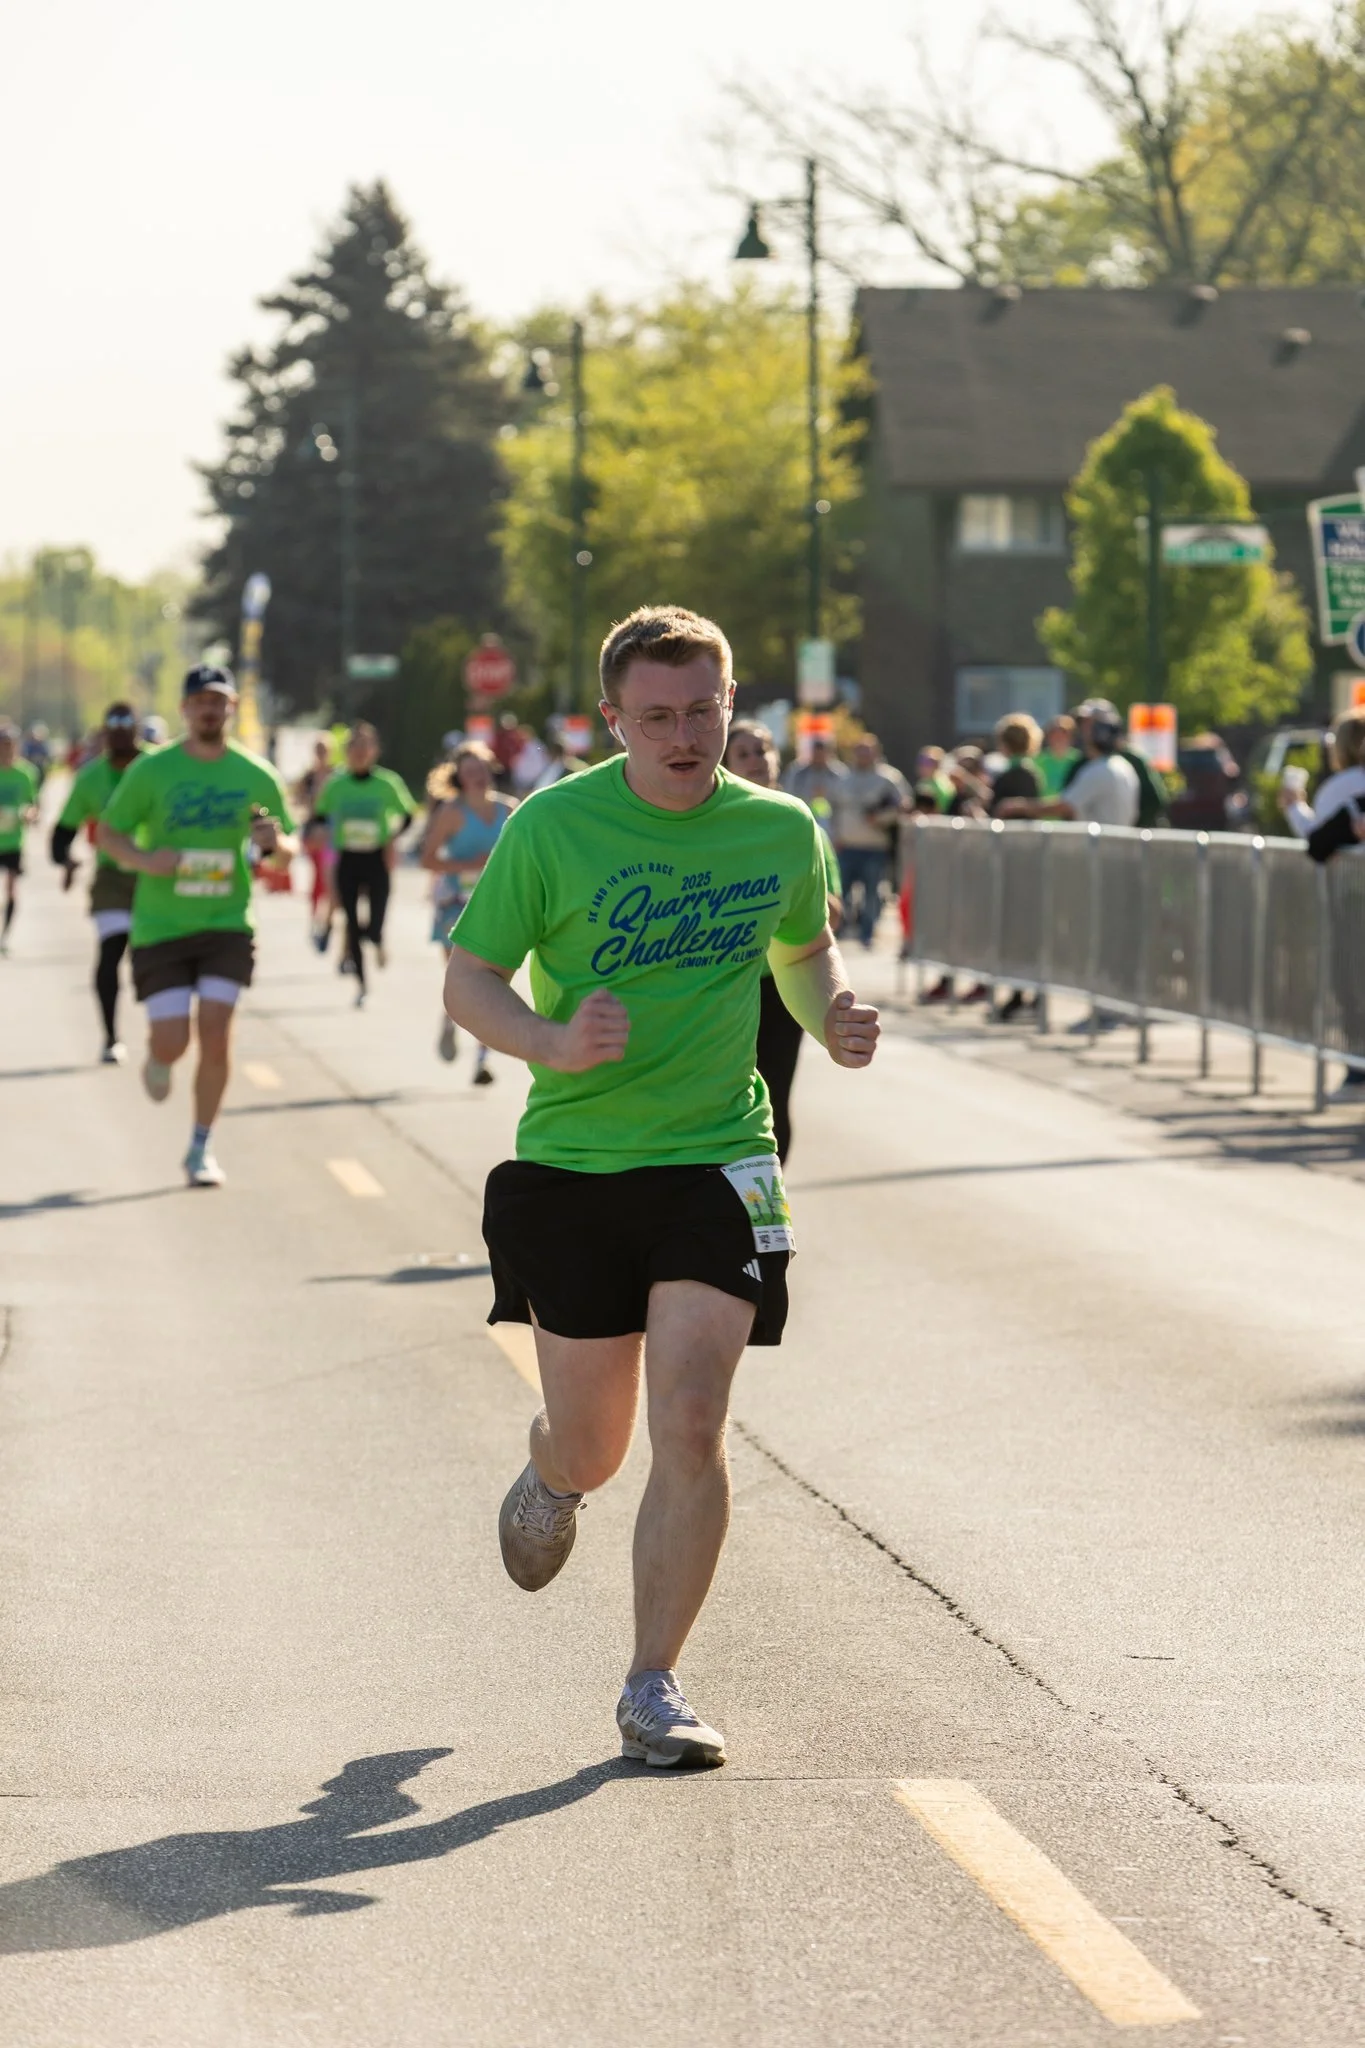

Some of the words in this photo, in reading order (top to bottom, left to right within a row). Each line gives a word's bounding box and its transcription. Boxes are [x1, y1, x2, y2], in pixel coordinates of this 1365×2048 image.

[620, 863, 644, 880] MILE
[648, 862, 675, 877] RACE
[606, 875, 619, 888] 10
[681, 871, 712, 891] 2025
[592, 887, 608, 908] AND
[608, 873, 781, 933] Quarryman
[588, 910, 598, 923] 5K
[591, 912, 758, 976] Challenge
[675, 955, 715, 969] LEMONT
